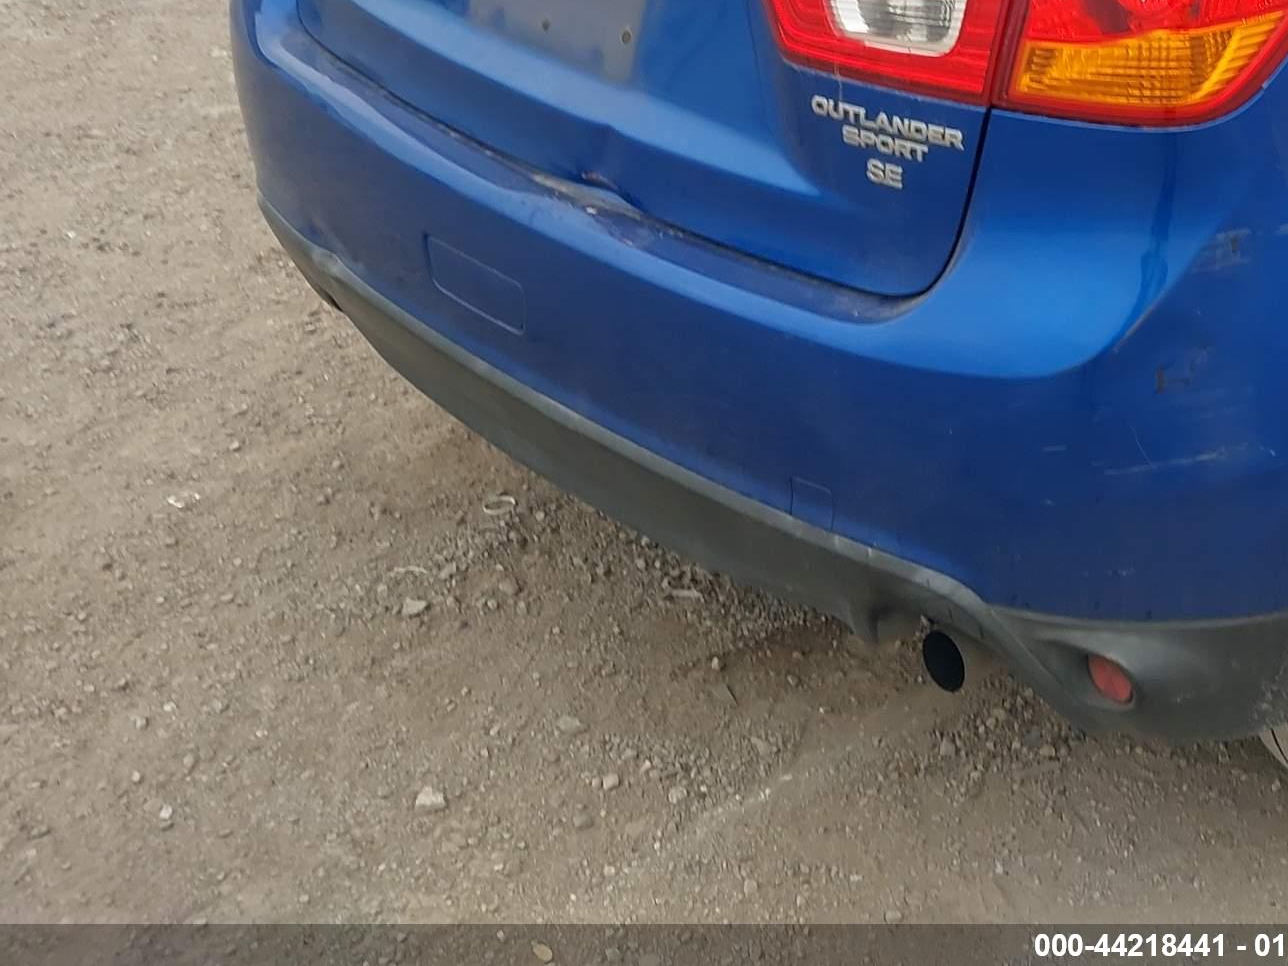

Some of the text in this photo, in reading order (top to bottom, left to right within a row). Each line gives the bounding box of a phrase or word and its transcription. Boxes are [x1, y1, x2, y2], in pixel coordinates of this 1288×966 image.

[811, 94, 965, 151] OUTLANDER
[841, 124, 929, 163] SPORT
[866, 157, 904, 190] SE
